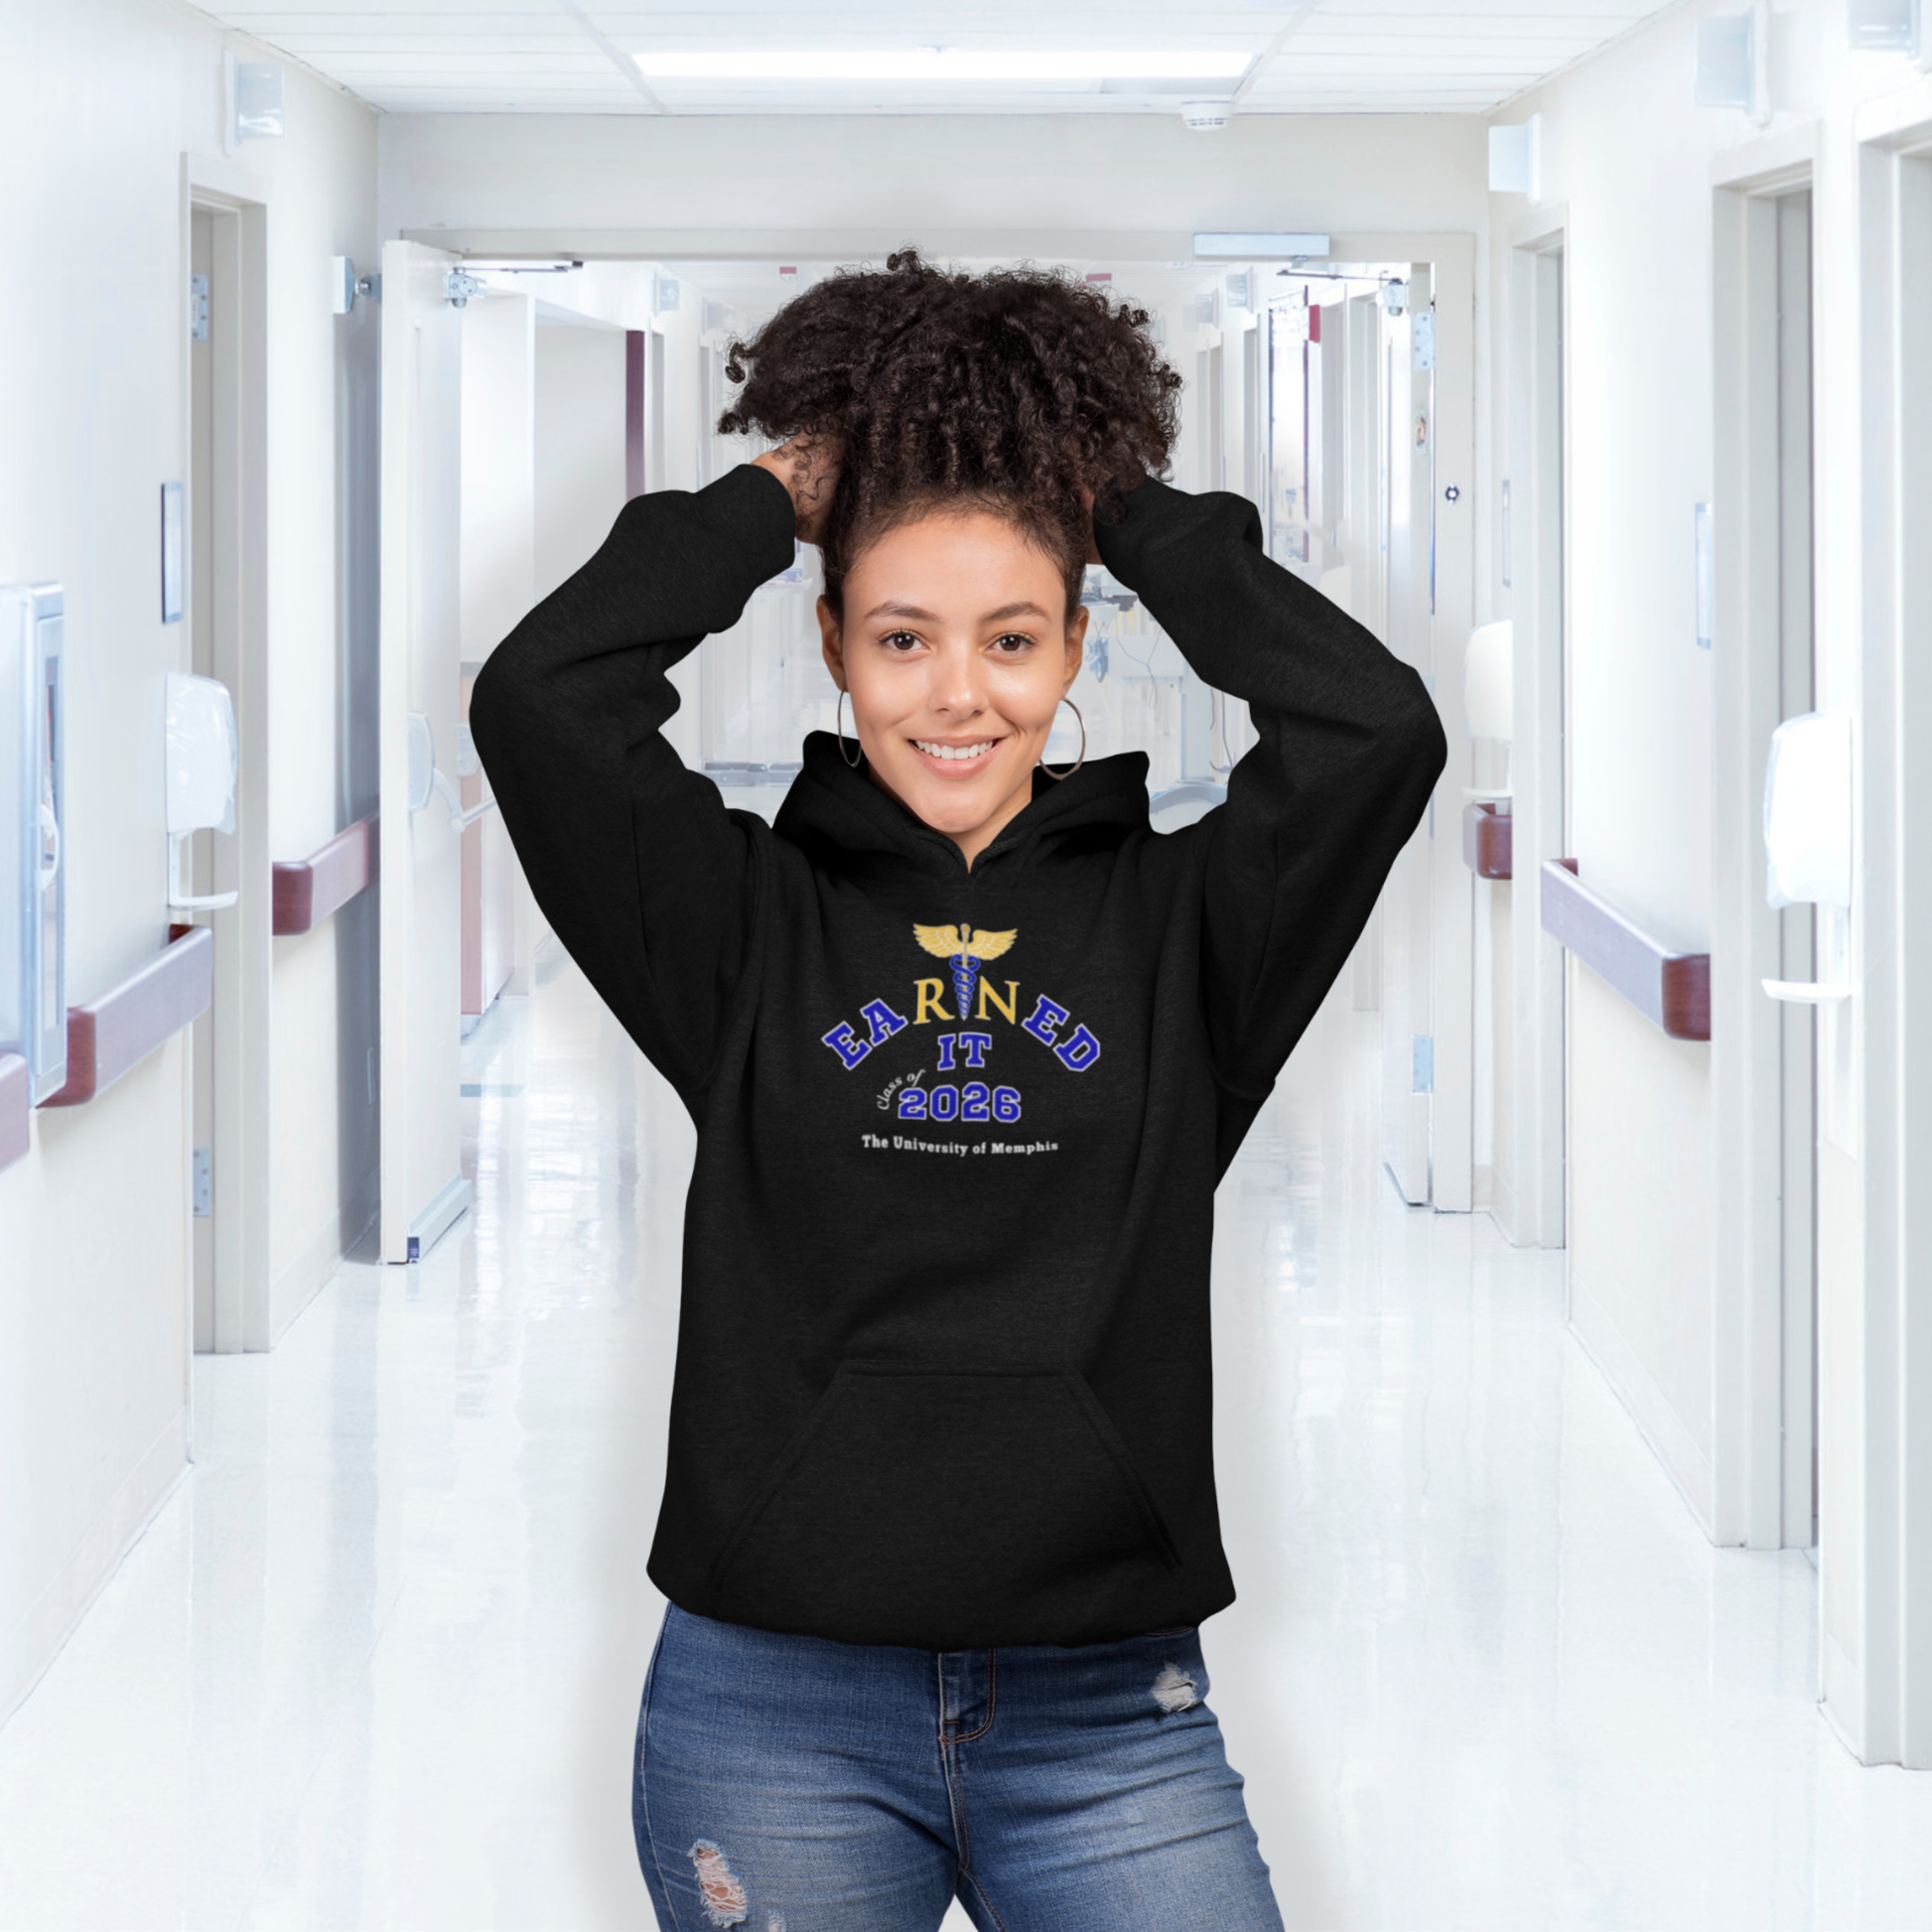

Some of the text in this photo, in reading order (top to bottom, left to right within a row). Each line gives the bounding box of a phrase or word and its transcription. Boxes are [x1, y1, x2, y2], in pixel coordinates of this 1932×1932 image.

[821, 976, 1101, 1072] EARNED
[937, 1032, 992, 1070] IT
[877, 1068, 925, 1111] Class of
[897, 1081, 1022, 1123] 2026
[862, 1134, 1058, 1157] The University of Memphis
